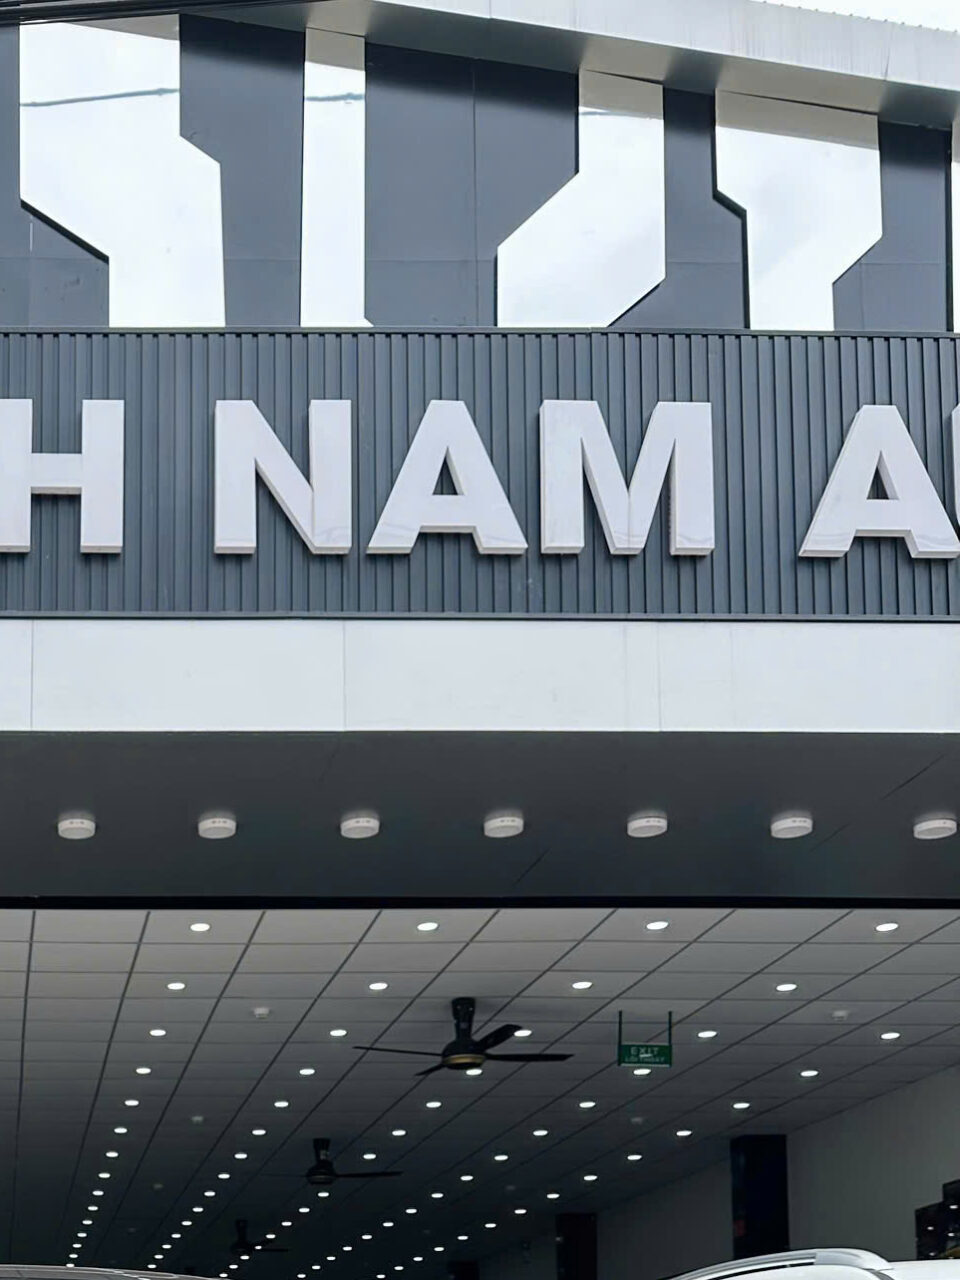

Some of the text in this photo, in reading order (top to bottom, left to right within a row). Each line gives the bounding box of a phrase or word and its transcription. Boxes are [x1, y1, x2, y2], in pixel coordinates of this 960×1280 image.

[214, 400, 715, 556] NAM
[798, 404, 960, 558] A
[631, 1046, 658, 1056] EXIT
